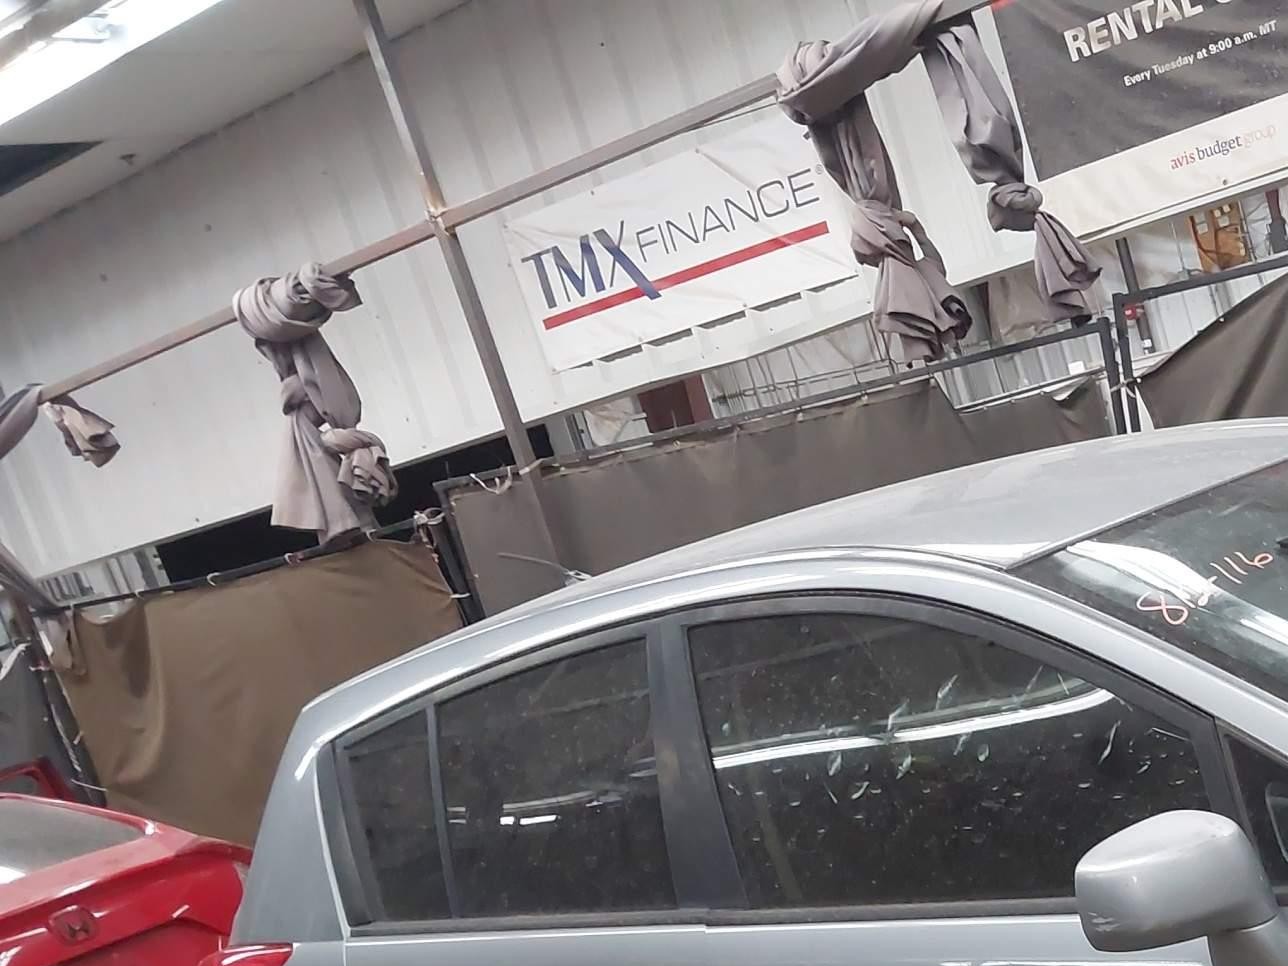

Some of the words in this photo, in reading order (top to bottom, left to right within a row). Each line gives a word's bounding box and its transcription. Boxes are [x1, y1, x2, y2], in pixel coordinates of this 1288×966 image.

[1063, 0, 1204, 62] RENTAL
[1123, 69, 1151, 87] Every
[1152, 53, 1195, 76] Tuesday
[1196, 48, 1208, 60] at
[1208, 37, 1233, 55] 9:00
[1234, 31, 1258, 46] a.m.
[1259, 20, 1278, 36] MT
[1170, 151, 1196, 170] avis
[1195, 135, 1243, 161] budget
[521, 220, 662, 309] TMX
[635, 168, 820, 263] FINANCE
